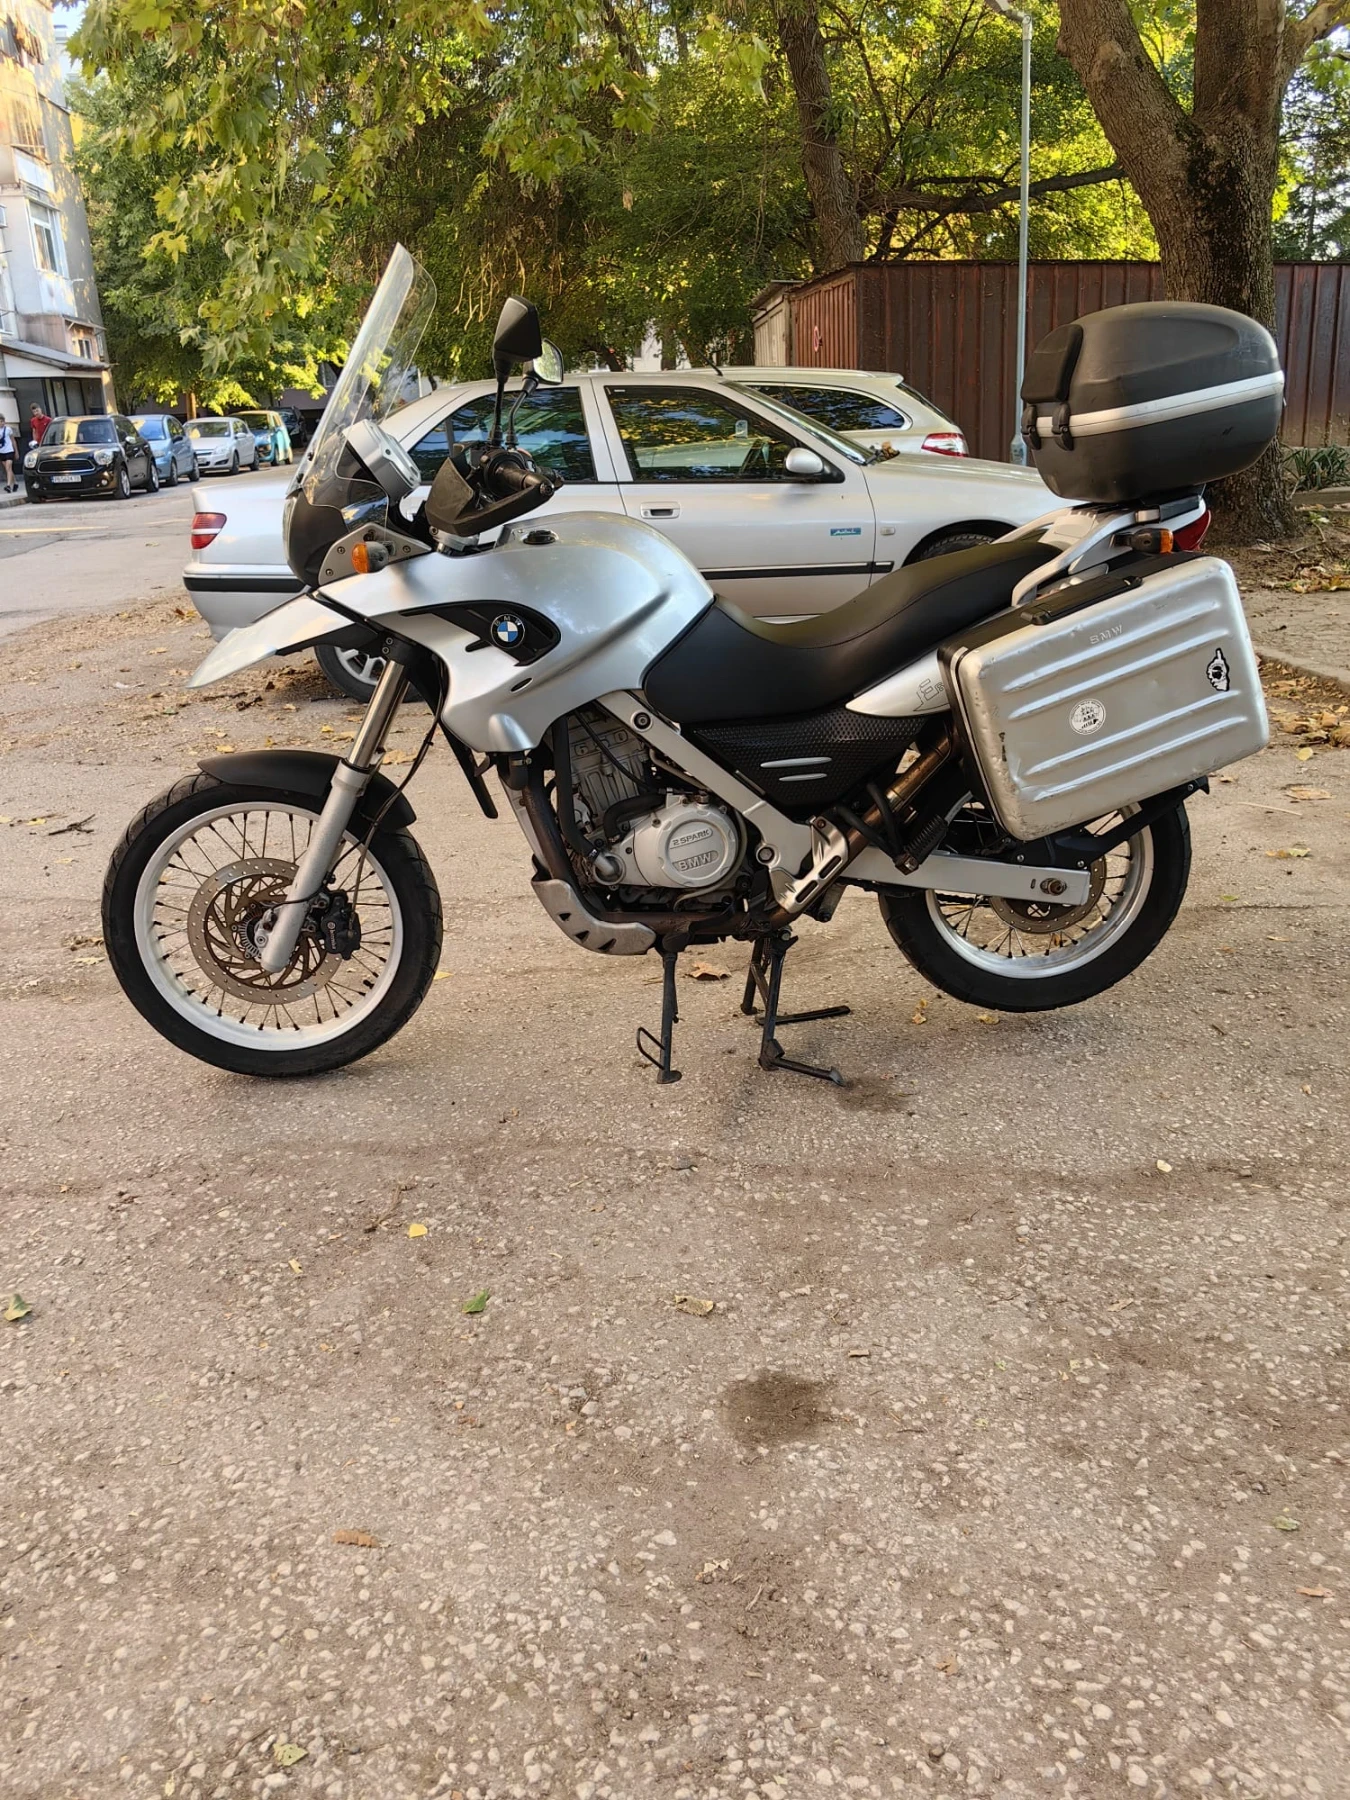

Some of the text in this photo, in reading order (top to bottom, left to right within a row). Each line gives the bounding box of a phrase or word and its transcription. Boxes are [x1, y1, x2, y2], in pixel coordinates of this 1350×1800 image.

[494, 615, 522, 626] BMW
[1089, 624, 1122, 645] BMW
[678, 852, 712, 872] BMW
